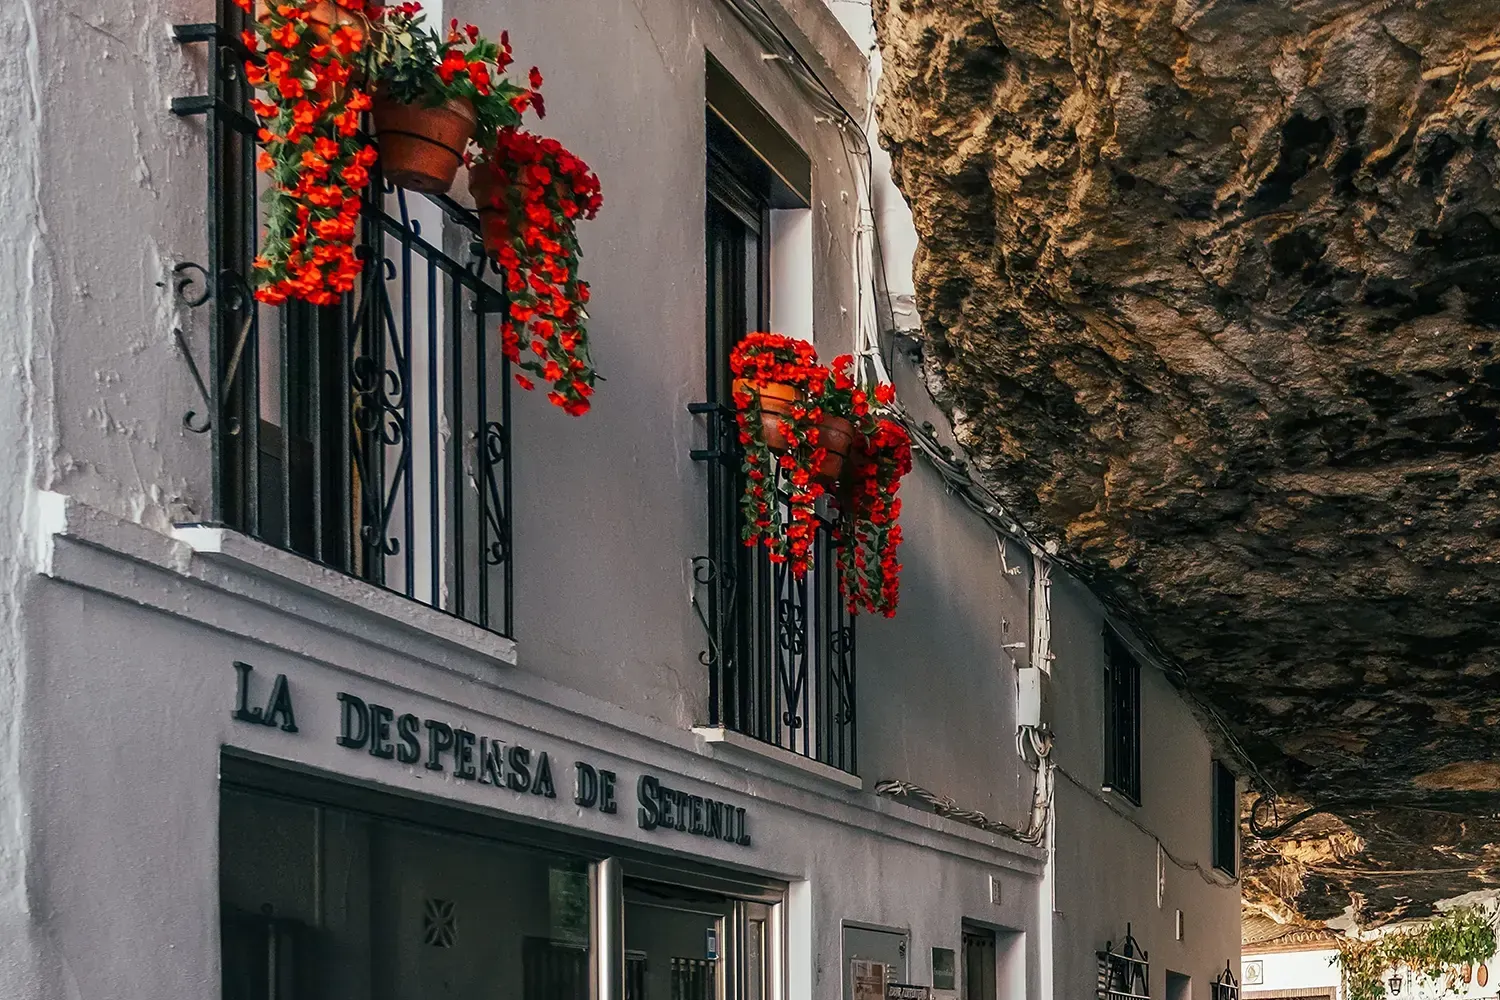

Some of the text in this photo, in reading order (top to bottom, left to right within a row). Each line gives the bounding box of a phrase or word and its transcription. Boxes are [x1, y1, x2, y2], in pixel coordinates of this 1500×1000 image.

[232, 661, 751, 847] LA DESPENSA DE SETENIL
